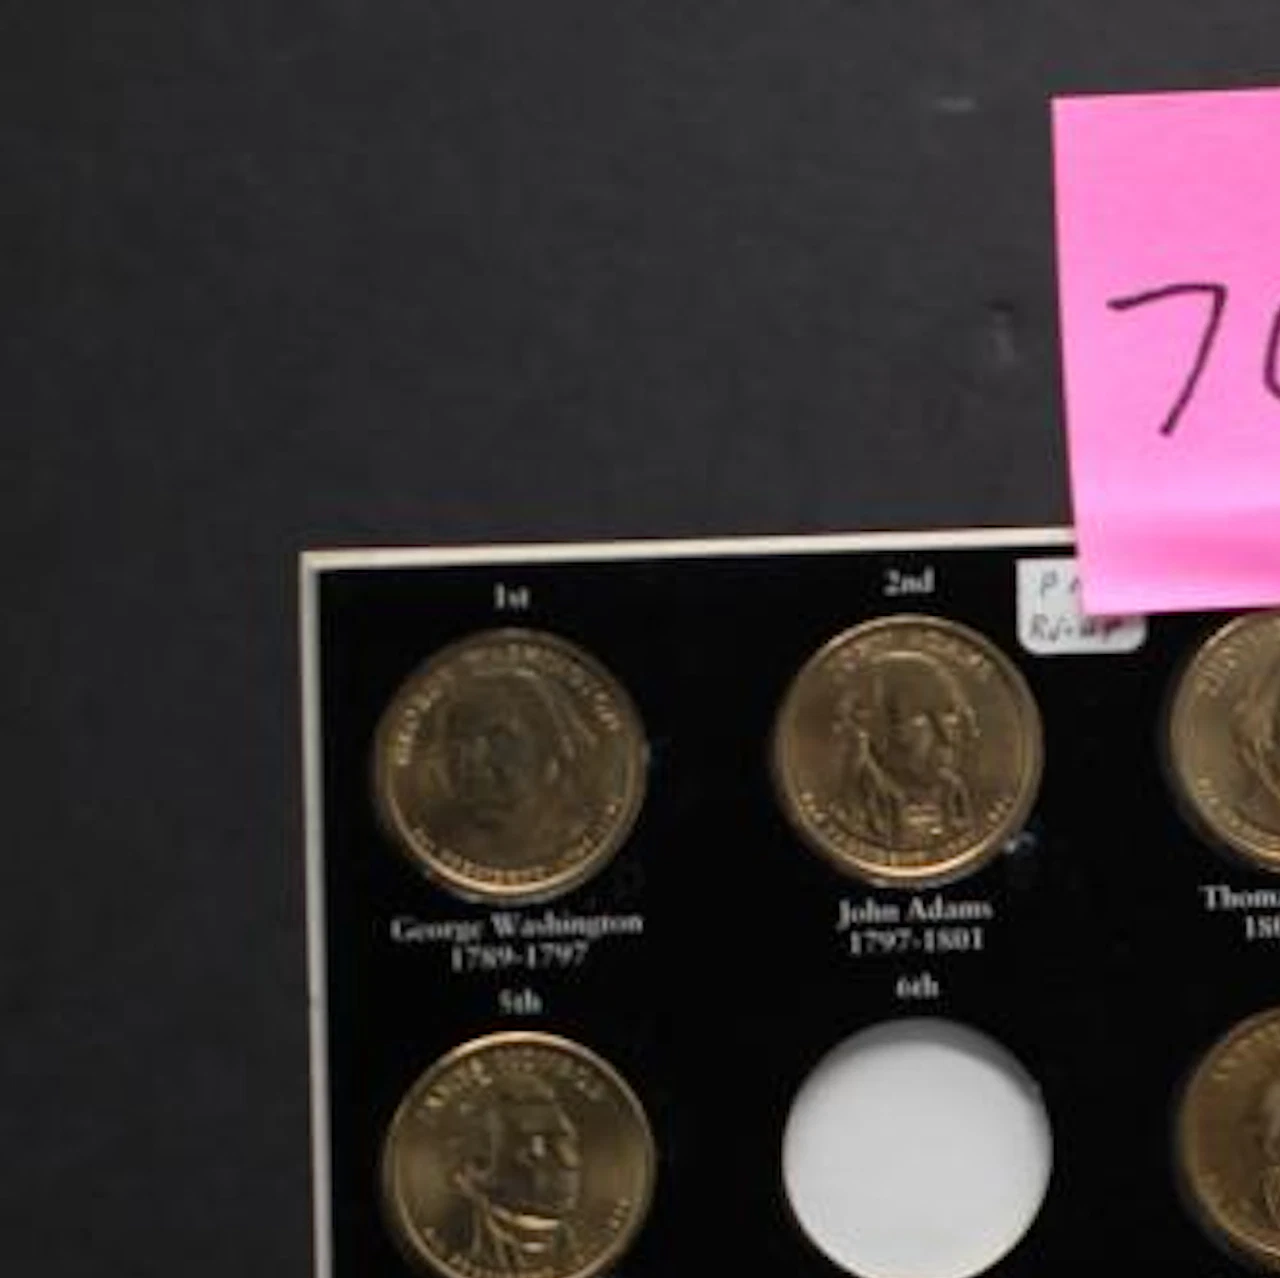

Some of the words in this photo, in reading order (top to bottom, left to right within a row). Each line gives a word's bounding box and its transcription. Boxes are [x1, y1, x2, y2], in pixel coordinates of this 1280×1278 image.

[1107, 281, 1227, 437] 7
[494, 582, 531, 610] 1st
[883, 566, 936, 596] 2nd
[391, 918, 485, 944] George
[490, 911, 643, 940] Washington
[837, 899, 899, 930] John
[906, 897, 994, 922] Adams
[849, 928, 985, 955] 1797-1801
[450, 942, 590, 972] 1789-1797
